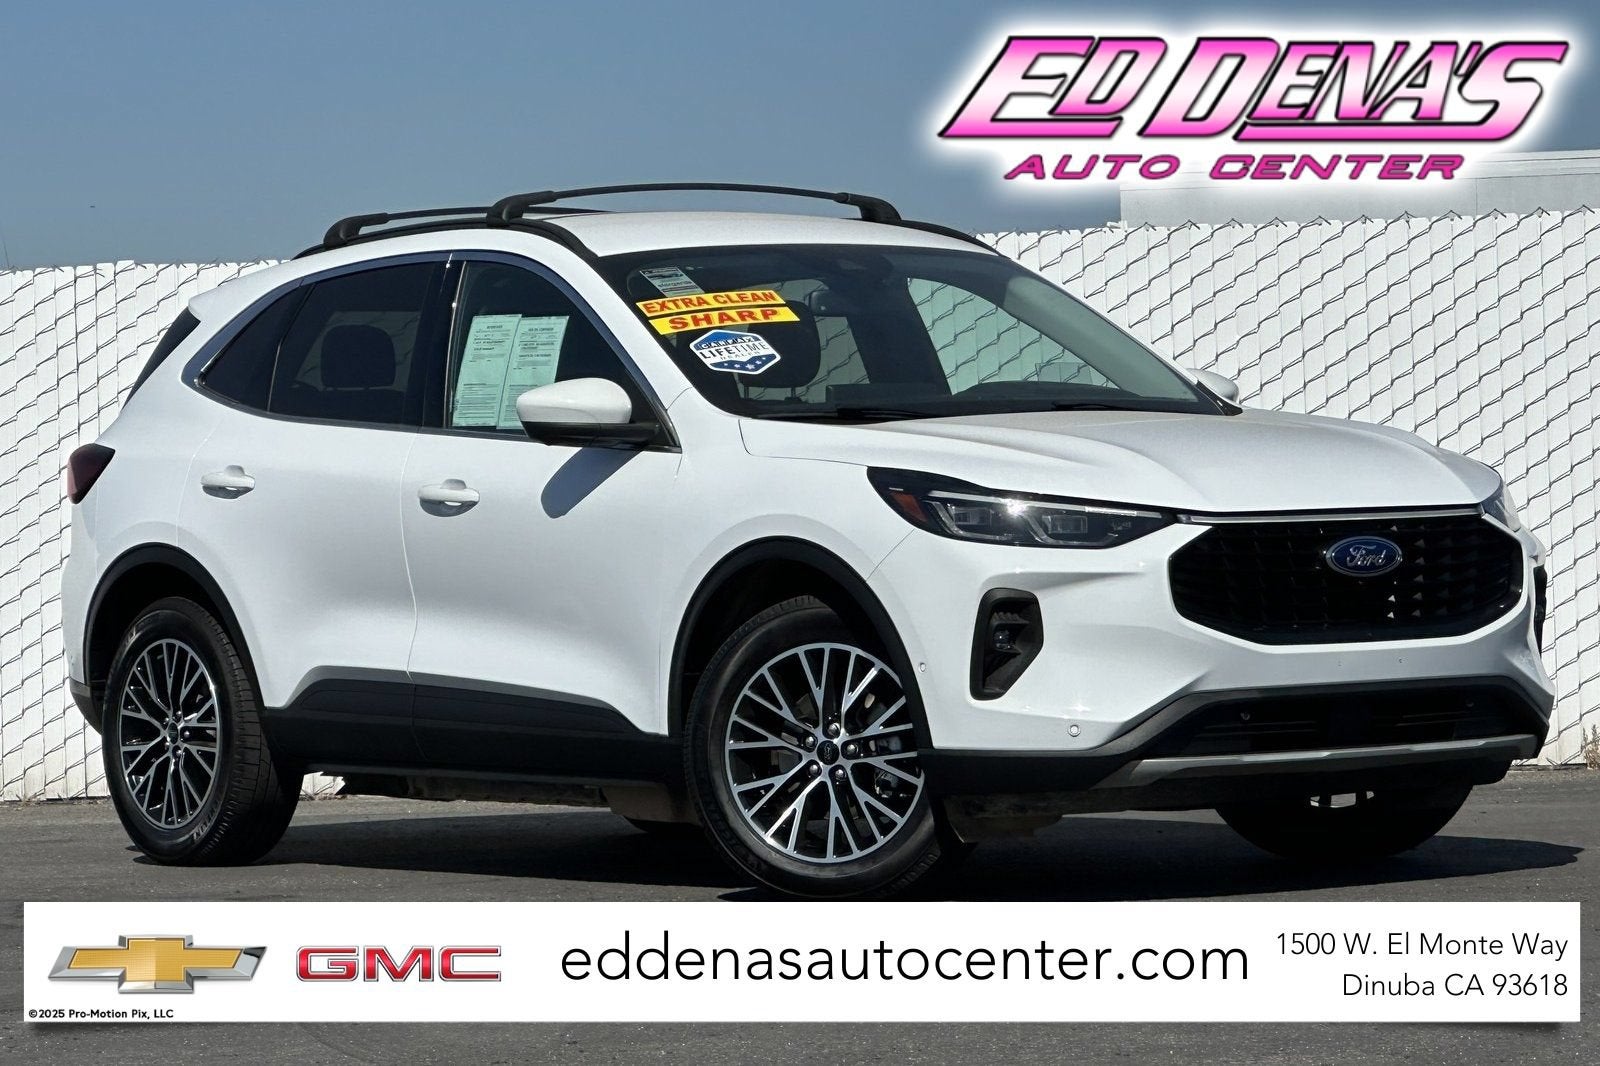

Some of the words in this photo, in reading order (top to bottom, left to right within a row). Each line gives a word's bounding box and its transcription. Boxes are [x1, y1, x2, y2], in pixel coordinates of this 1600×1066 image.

[643, 295, 706, 314] EXTRA
[712, 292, 777, 306] CLEAN
[668, 308, 779, 330] SHARP
[699, 342, 770, 359] LIFETIME
[1346, 544, 1387, 567] Ford
